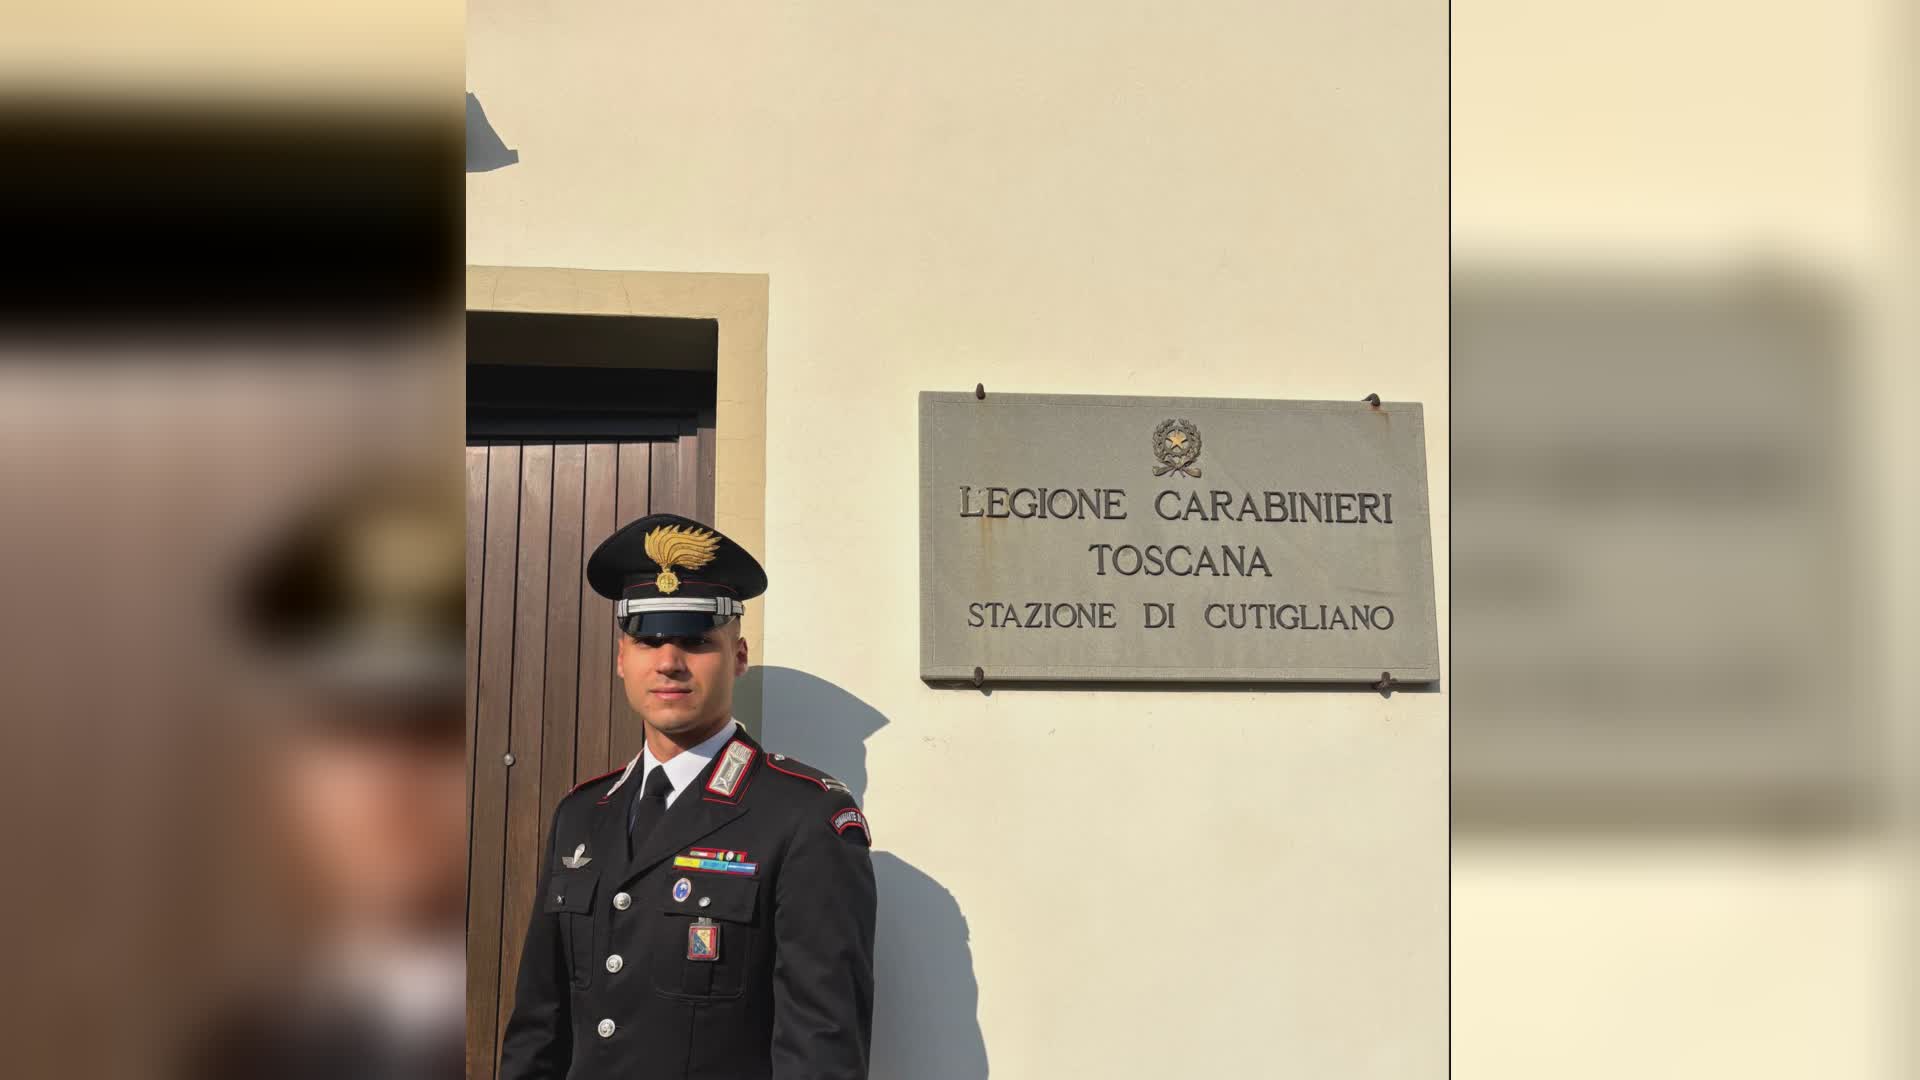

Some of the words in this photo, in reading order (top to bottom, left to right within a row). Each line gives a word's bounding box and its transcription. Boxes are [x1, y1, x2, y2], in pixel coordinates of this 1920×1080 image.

[960, 486, 1127, 520] LEGIONE
[1155, 490, 1393, 524] CARABINIERI
[1089, 544, 1273, 577] TOSCANA
[968, 602, 1117, 629] STAZIONE
[1144, 603, 1175, 629] DI
[1205, 604, 1395, 631] CUTIGLIANO
